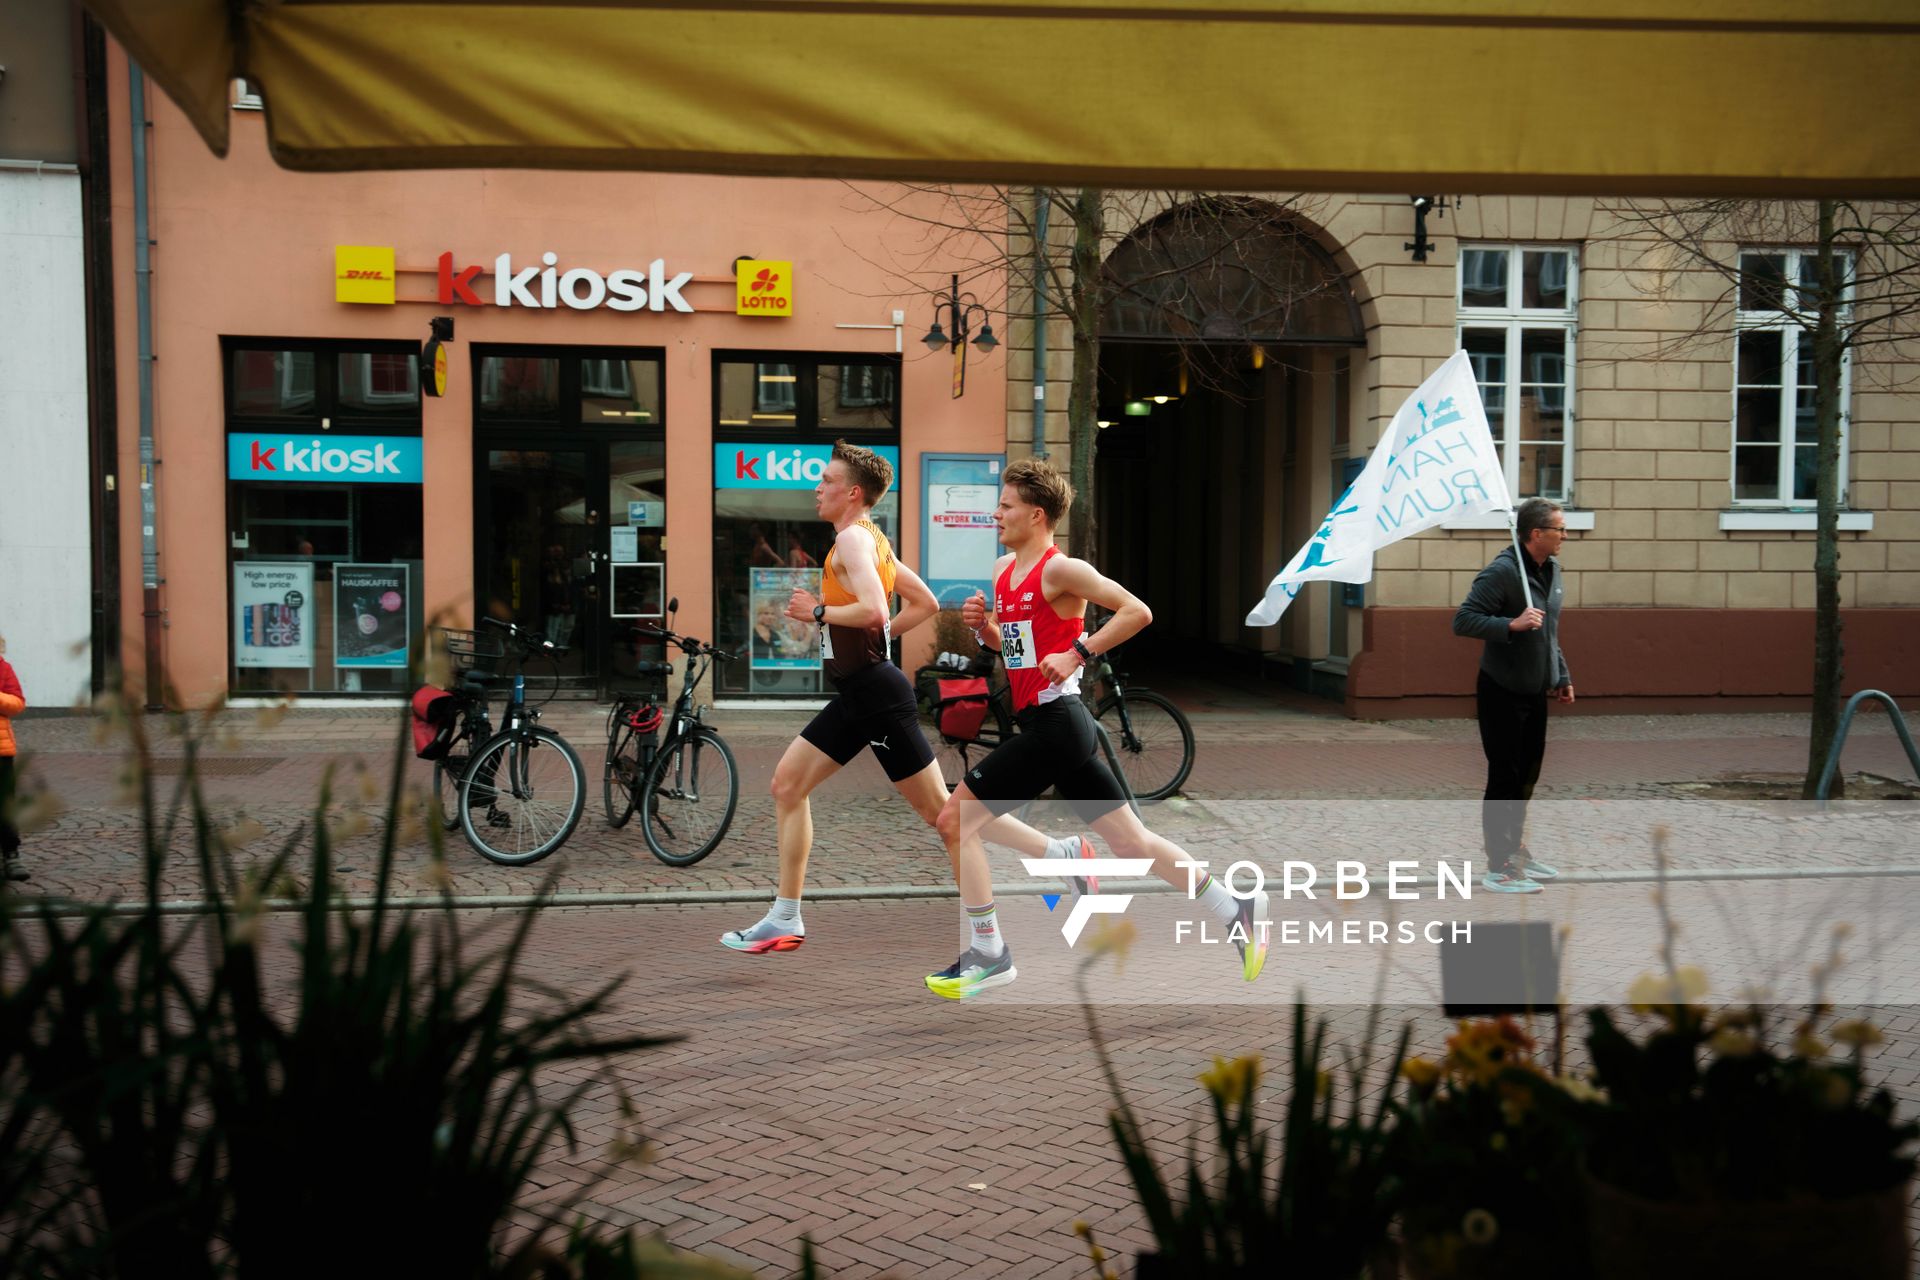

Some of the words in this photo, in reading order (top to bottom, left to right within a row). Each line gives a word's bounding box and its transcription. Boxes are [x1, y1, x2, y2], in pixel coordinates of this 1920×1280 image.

[345, 270, 383, 281] DHL
[438, 251, 483, 306] k
[494, 252, 694, 314] kiosk
[741, 295, 788, 310] LOTTO
[250, 440, 277, 472] k
[283, 439, 401, 474] kiosk
[735, 450, 760, 480] k
[766, 449, 828, 482] kio
[933, 514, 970, 523] NEWYORK
[971, 515, 994, 524] NAILS
[243, 571, 265, 581] High
[251, 580, 267, 589] low
[268, 581, 292, 590] price
[341, 579, 399, 587] HAUSKAFFEE
[973, 920, 993, 929] UAE
